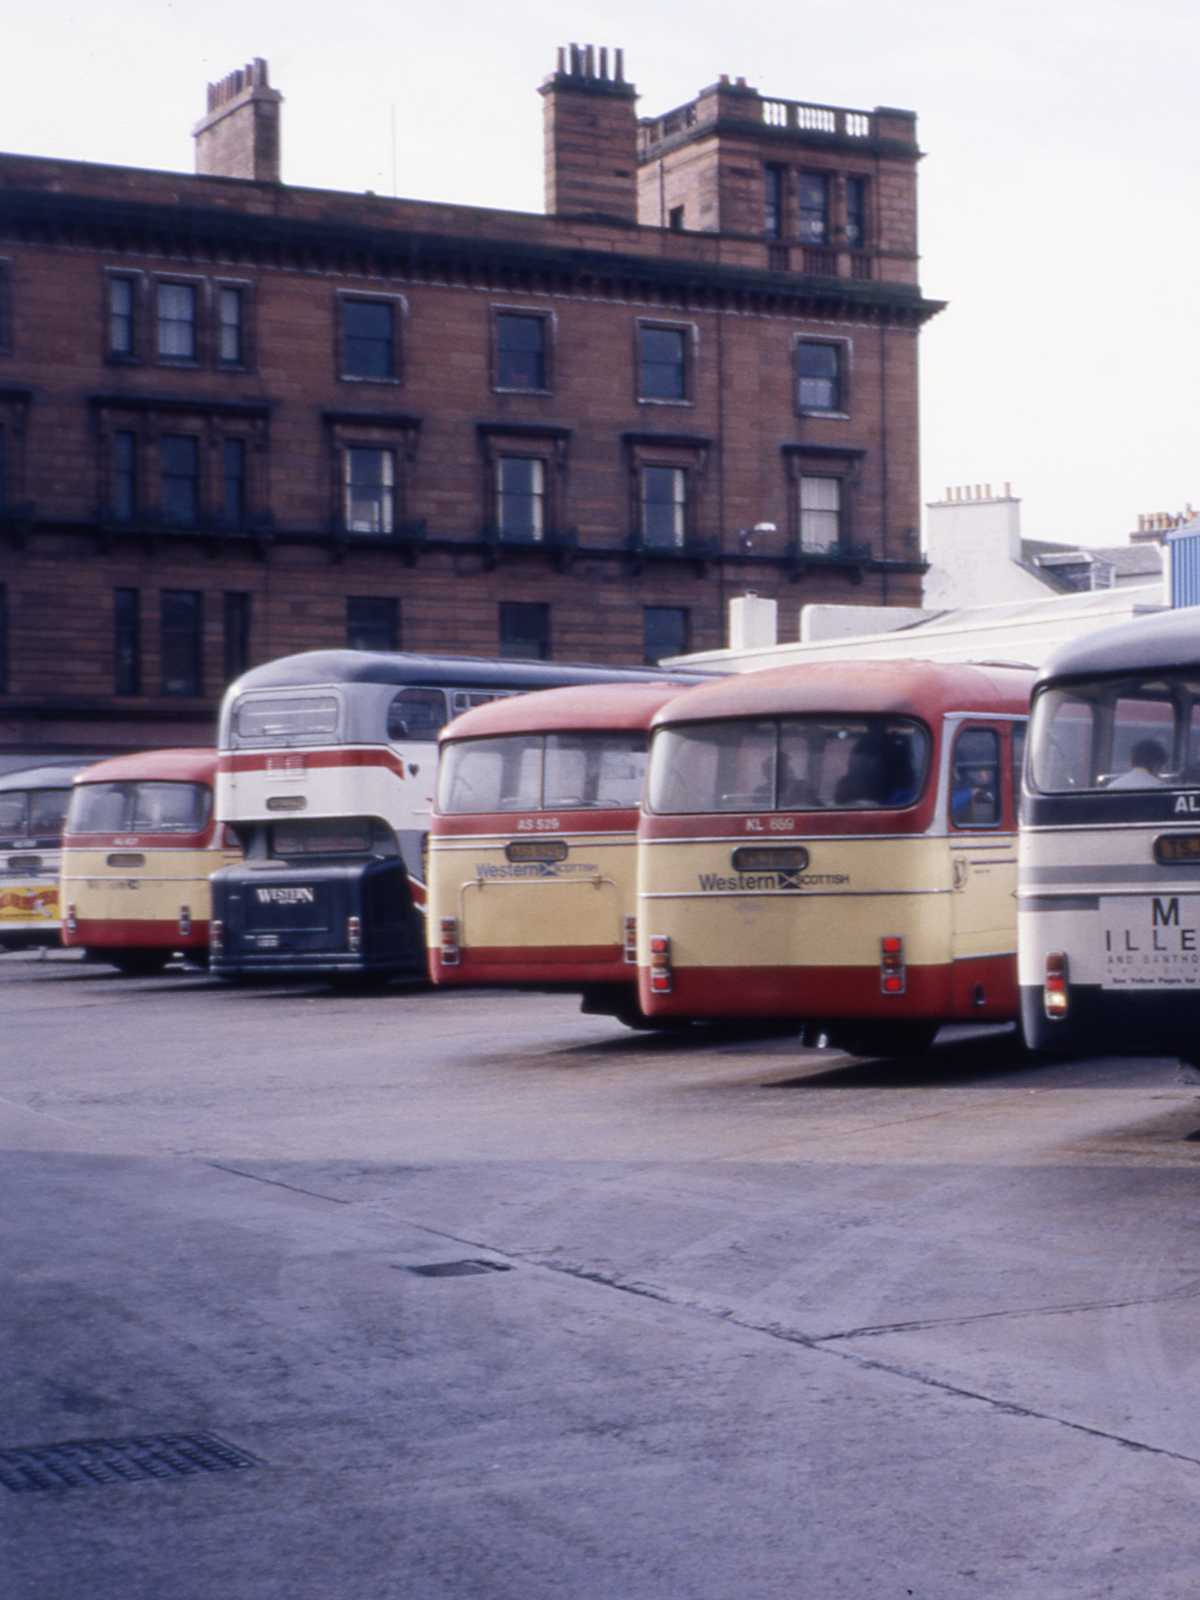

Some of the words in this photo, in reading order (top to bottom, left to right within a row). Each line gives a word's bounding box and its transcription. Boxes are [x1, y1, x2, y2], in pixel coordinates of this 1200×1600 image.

[1174, 796, 1200, 813] AL
[698, 872, 776, 891] Western
[1152, 897, 1179, 926] M
